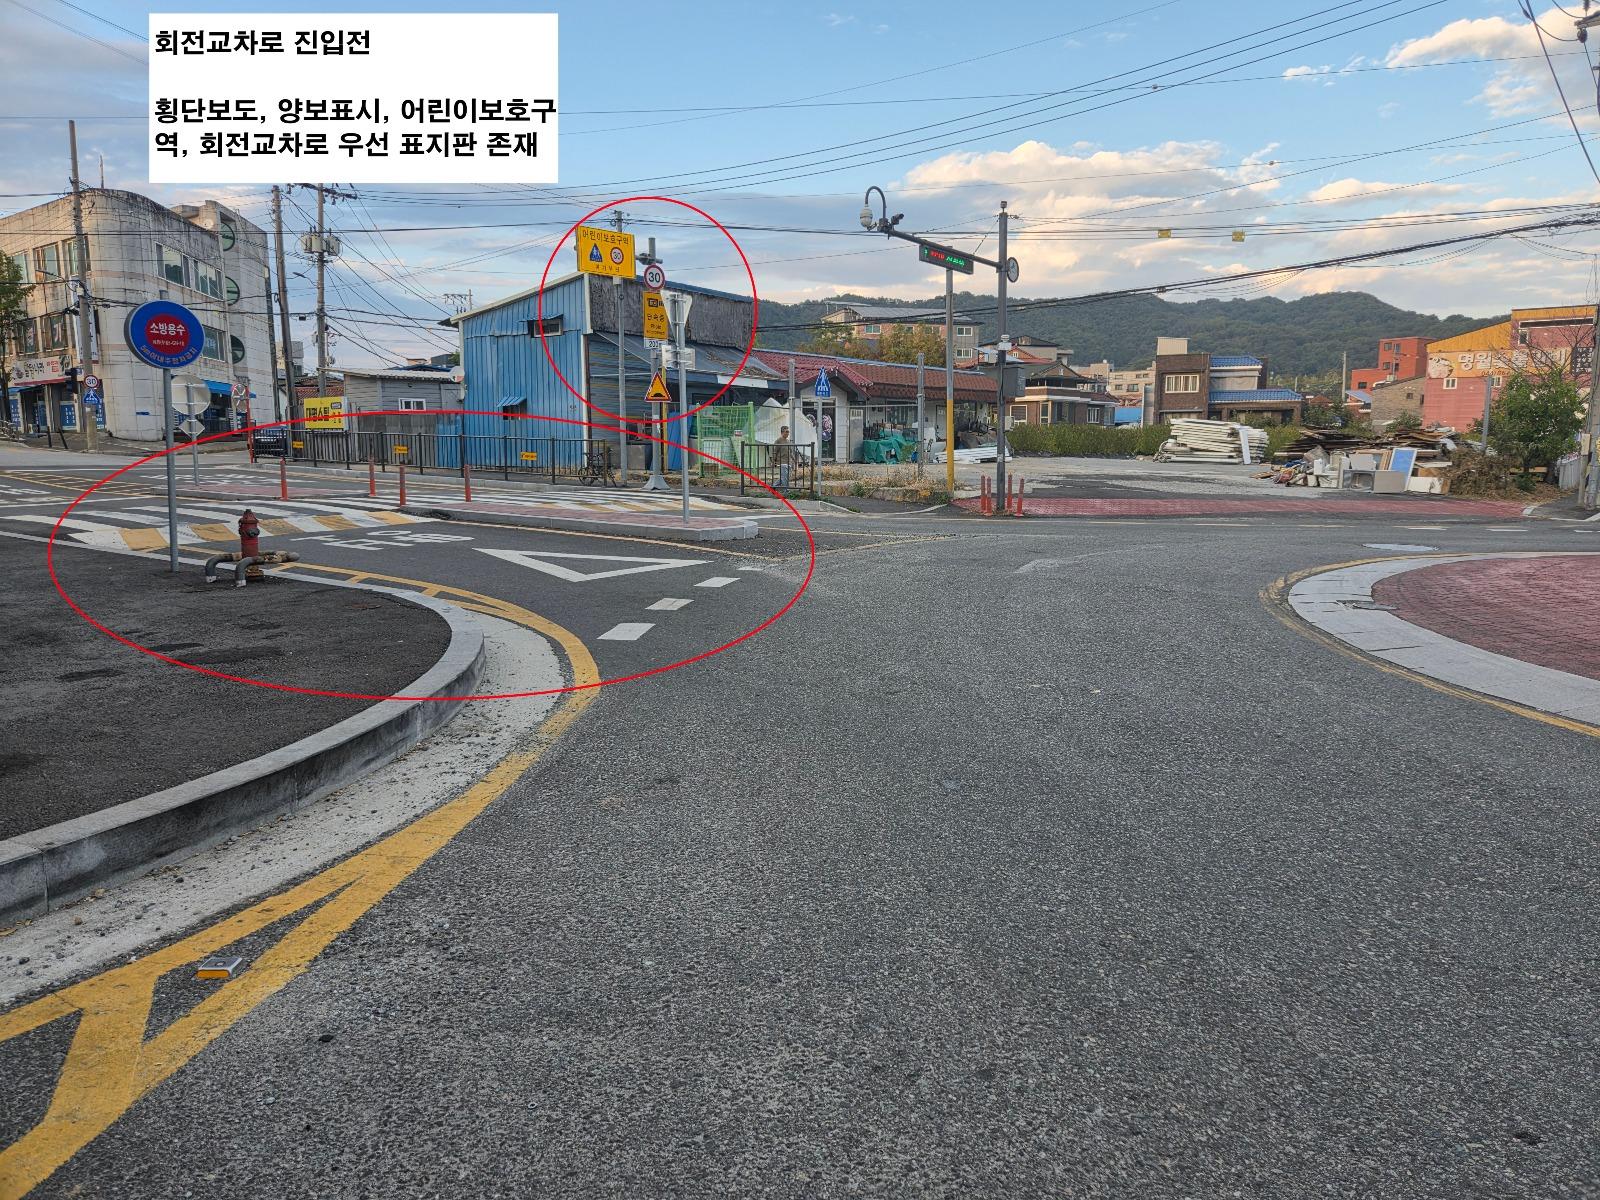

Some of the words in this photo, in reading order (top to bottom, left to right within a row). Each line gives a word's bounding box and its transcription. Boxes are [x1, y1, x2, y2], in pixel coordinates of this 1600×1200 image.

[648, 271, 661, 283] 30
[149, 322, 186, 337] 소방용수
[86, 377, 97, 386] 30
